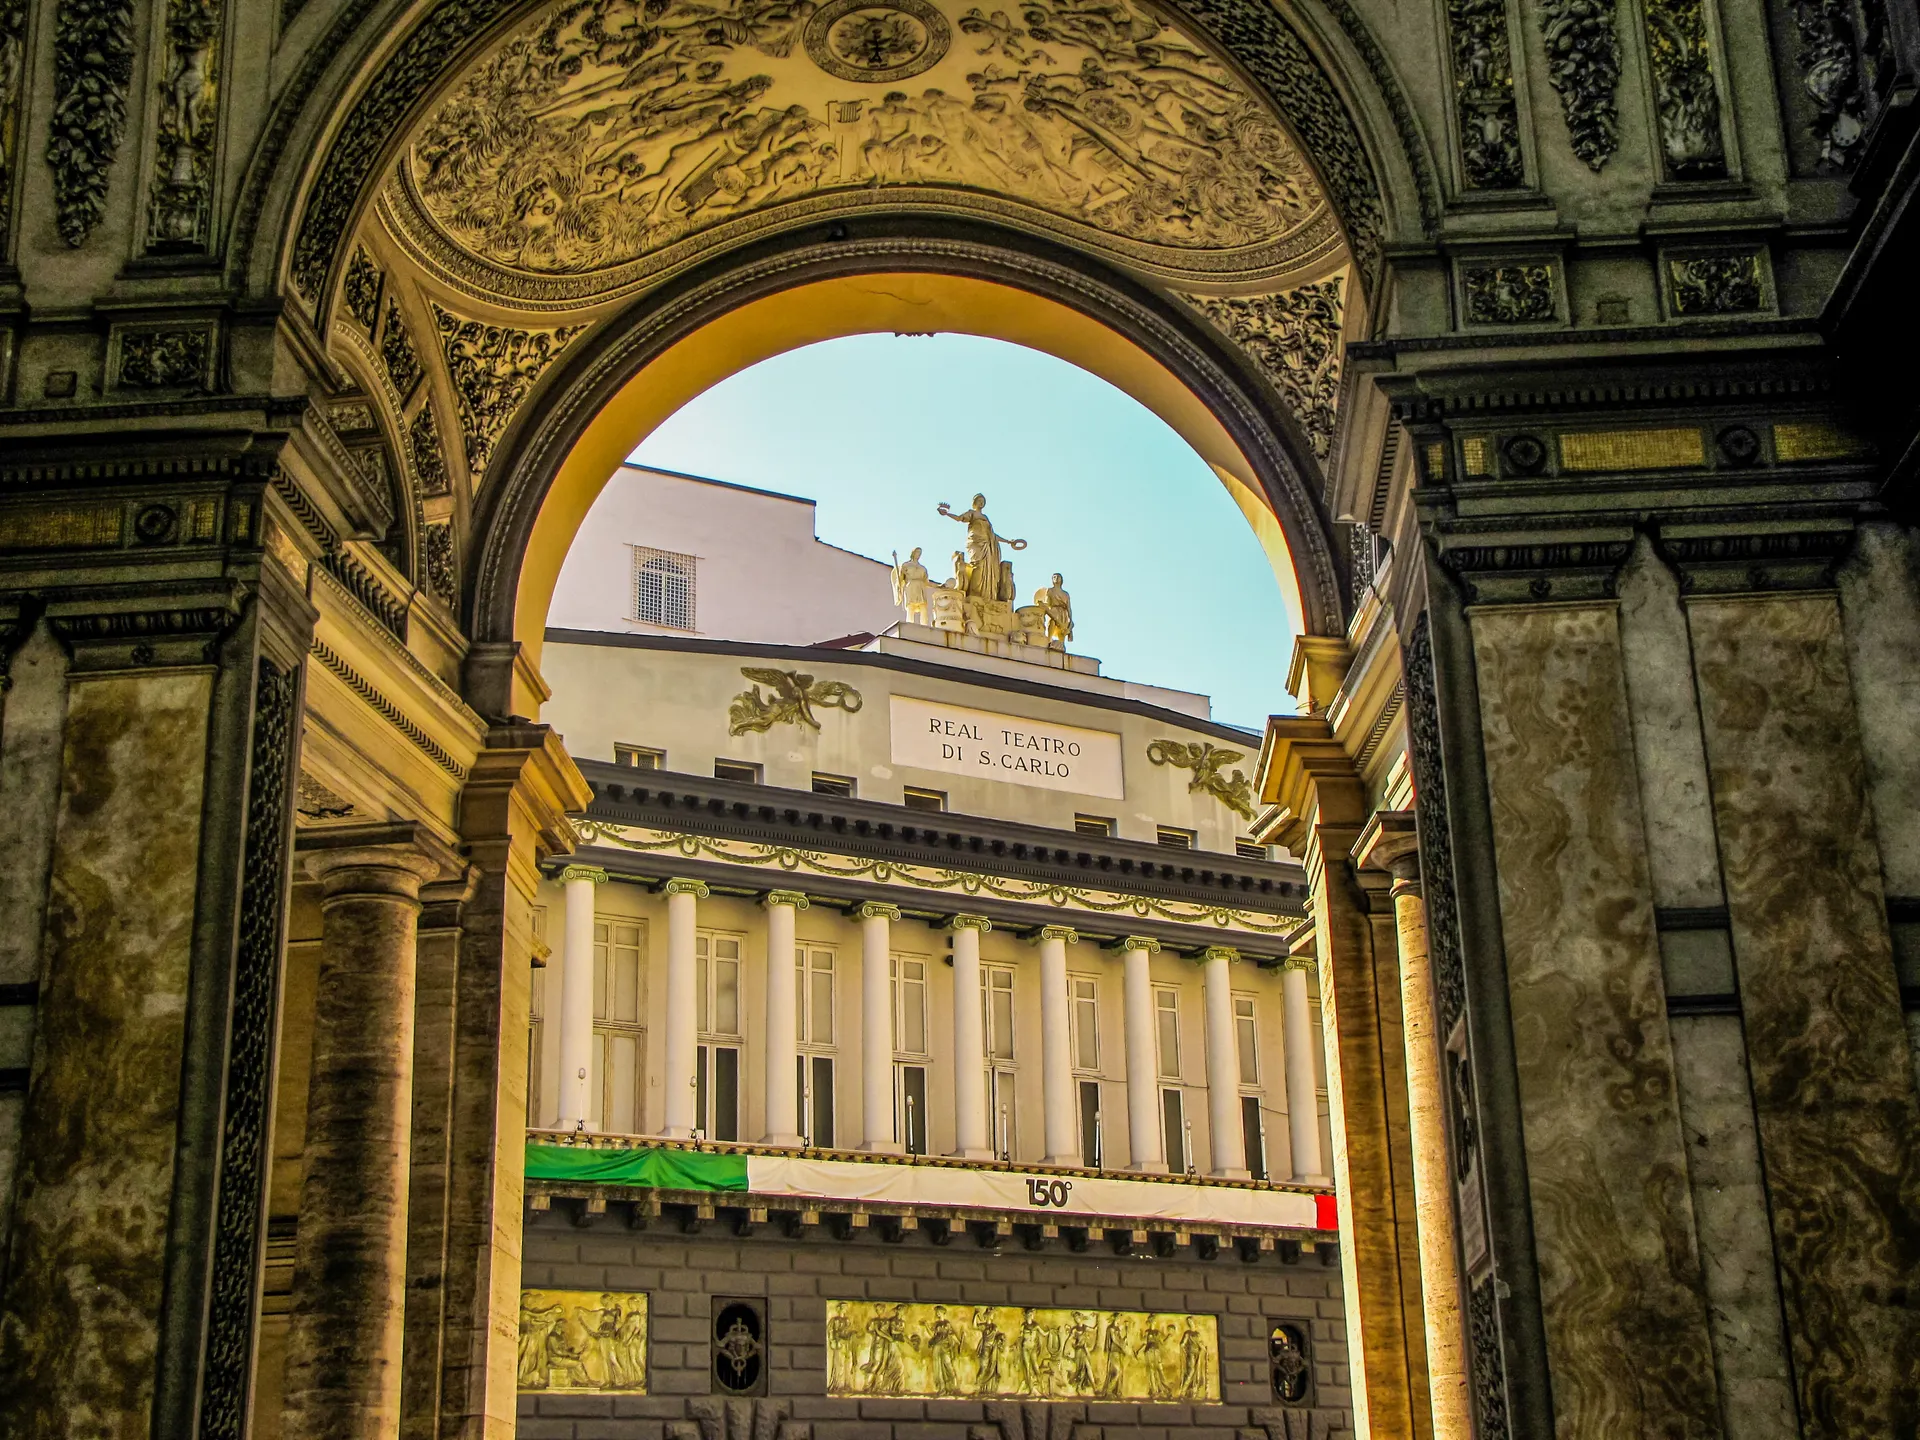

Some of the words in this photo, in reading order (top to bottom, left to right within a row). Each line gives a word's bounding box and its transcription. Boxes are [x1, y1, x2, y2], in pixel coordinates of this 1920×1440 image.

[928, 718, 983, 741] REAL
[1001, 730, 1081, 757] TEATRO
[942, 743, 963, 761] DI
